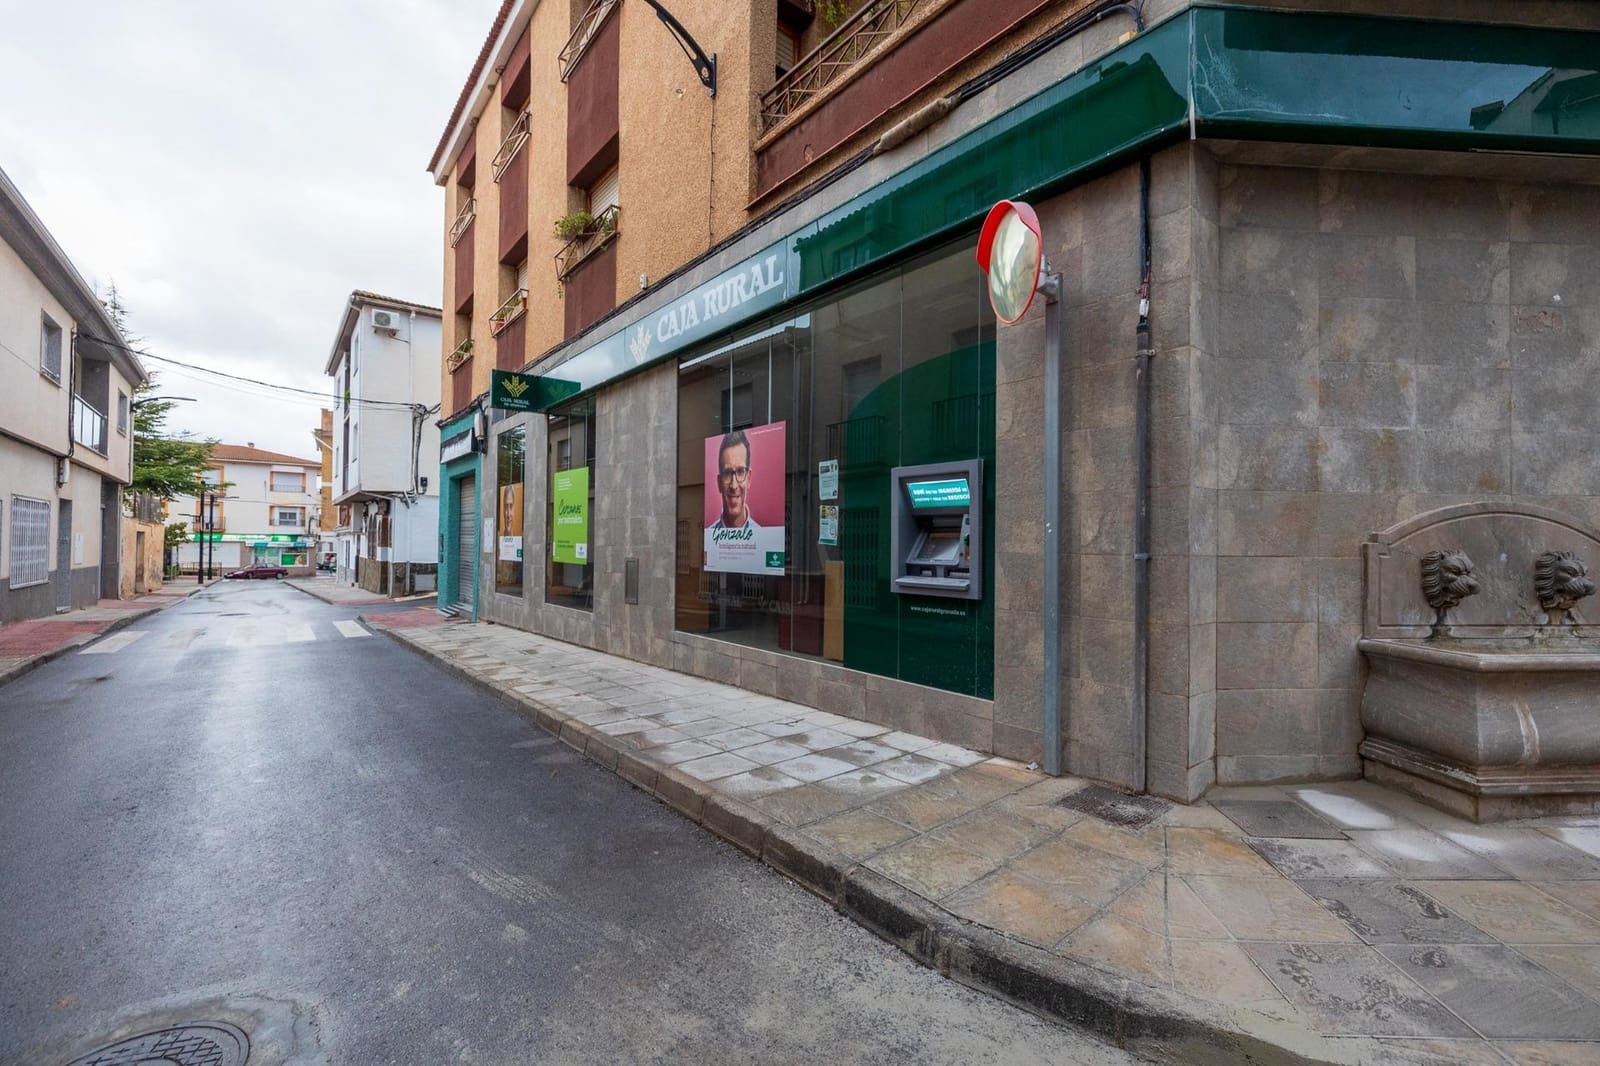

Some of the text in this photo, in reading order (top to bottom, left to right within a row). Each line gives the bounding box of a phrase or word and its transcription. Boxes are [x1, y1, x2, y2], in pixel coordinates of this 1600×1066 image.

[657, 255, 784, 343] CAJA RURAL
[712, 521, 753, 545] Gonzalo
